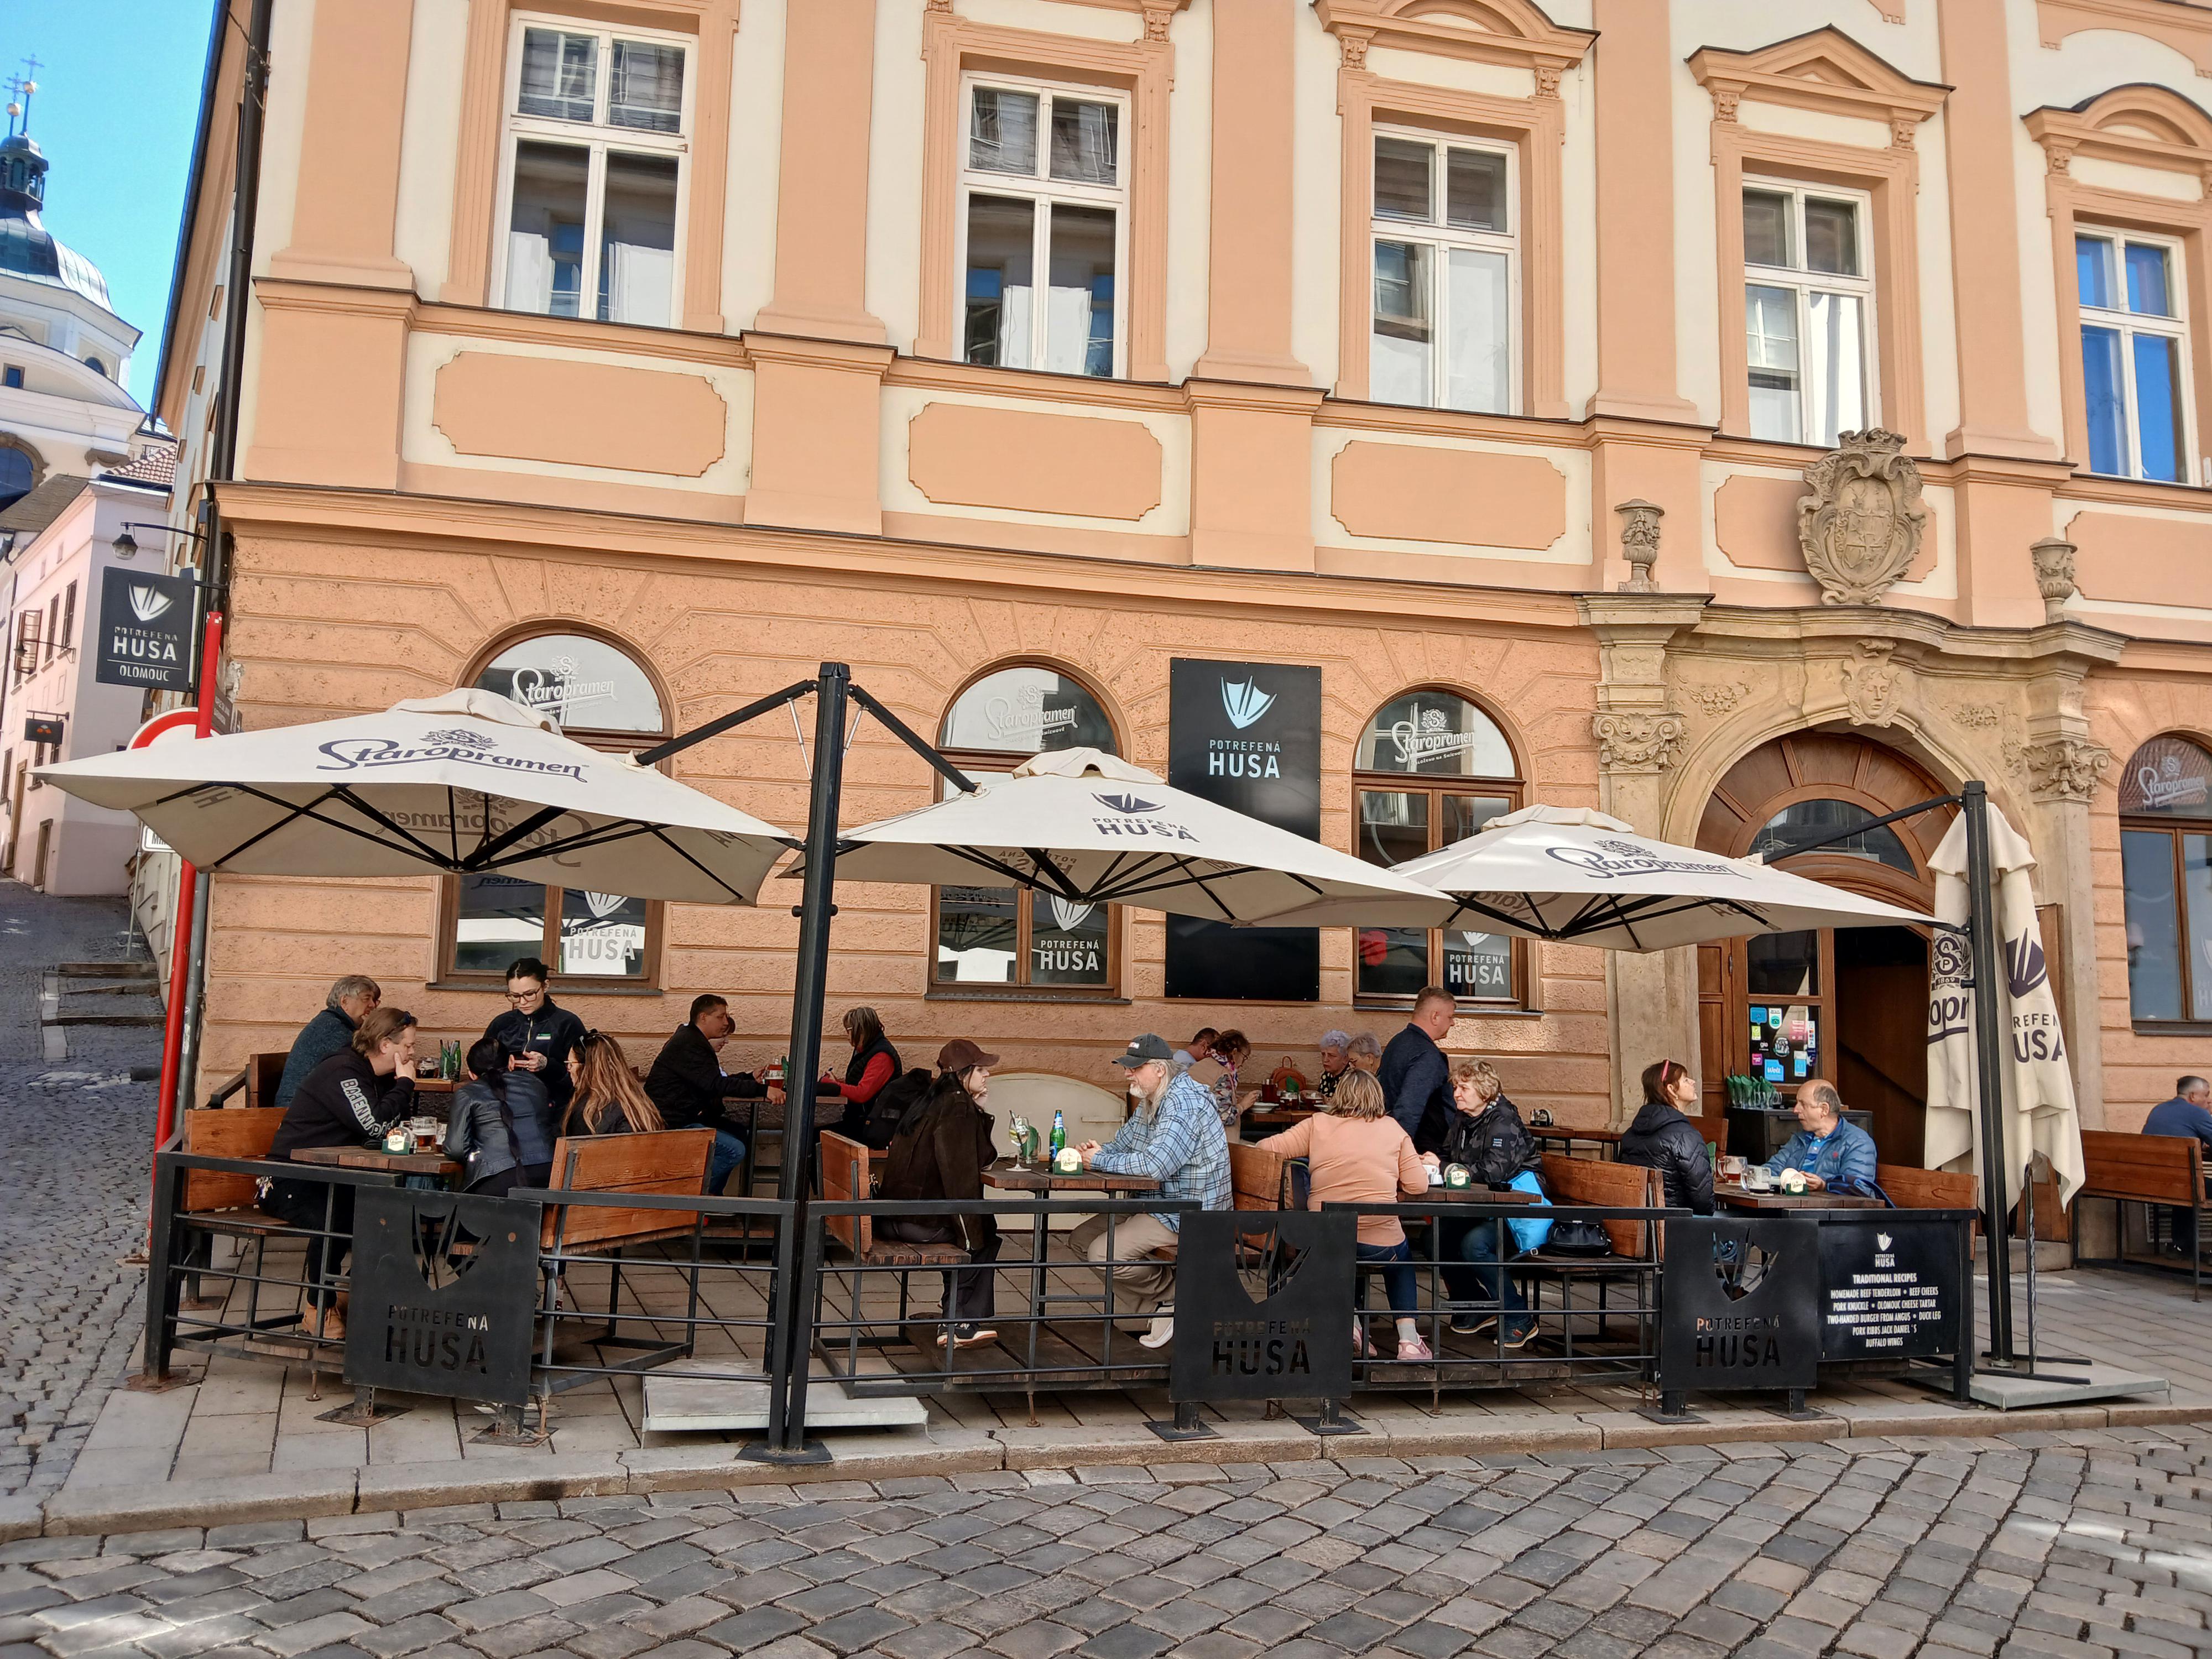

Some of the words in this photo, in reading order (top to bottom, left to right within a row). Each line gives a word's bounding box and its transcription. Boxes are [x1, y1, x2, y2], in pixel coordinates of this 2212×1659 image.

[113, 635, 176, 661] HUSA
[119, 665, 170, 681] OLOMOUC
[984, 697, 1078, 740] Staropramen
[1209, 739, 1281, 753] POTREFENÁ
[1392, 721, 1475, 763] Staropramen
[316, 739, 588, 783] Staropramen
[1209, 752, 1281, 779] HUSA
[1096, 824, 1201, 843] HUSA
[1545, 847, 1752, 880] Staropramen
[570, 927, 637, 938] POTREFENÁ
[569, 938, 635, 961] HUSA
[1041, 940, 1099, 949] POTREFENÁ
[1040, 951, 1099, 971] HUSA
[1450, 954, 1504, 964] POTREFENÁ
[1449, 964, 1504, 984] HUSA
[1875, 1258, 1895, 1267] HUSA
[1853, 1274, 1892, 1284] TRADITIONAL
[1893, 1273, 1917, 1282] RECIPES
[1830, 1289, 1859, 1299] HOMEMADE
[1860, 1288, 1871, 1298] BEEF
[1872, 1288, 1901, 1297] TENDERLOIN
[1909, 1287, 1920, 1296] BEEF
[1921, 1286, 1938, 1296] CHEEKS
[1833, 1302, 1846, 1311] PORK
[1848, 1301, 1869, 1311] KNUCKLE
[1877, 1301, 1901, 1310] OLOMOUC
[1902, 1300, 1918, 1309] CHEESE
[1919, 1299, 1936, 1308] TARTAR
[388, 1305, 489, 1331] POTREFENÁ
[1697, 1314, 1780, 1331] POTREFENÁ
[1827, 1314, 1859, 1324] TWO-HANDED
[1860, 1313, 1879, 1323] BURGER
[1880, 1313, 1894, 1322] FROM
[1895, 1312, 1911, 1321] ANGUS
[1919, 1311, 1932, 1321] DUCK
[1932, 1311, 1941, 1320] LEG
[1853, 1327, 1865, 1336] PORK
[1866, 1326, 1880, 1335] RIBBS
[1881, 1325, 1892, 1334] JACK
[385, 1325, 487, 1374] HUSA
[1696, 1334, 1781, 1368] HUSA
[1866, 1338, 1886, 1348] BUFFALO
[1887, 1337, 1903, 1346] WINGS
[1212, 1339, 1310, 1376] HUSA
